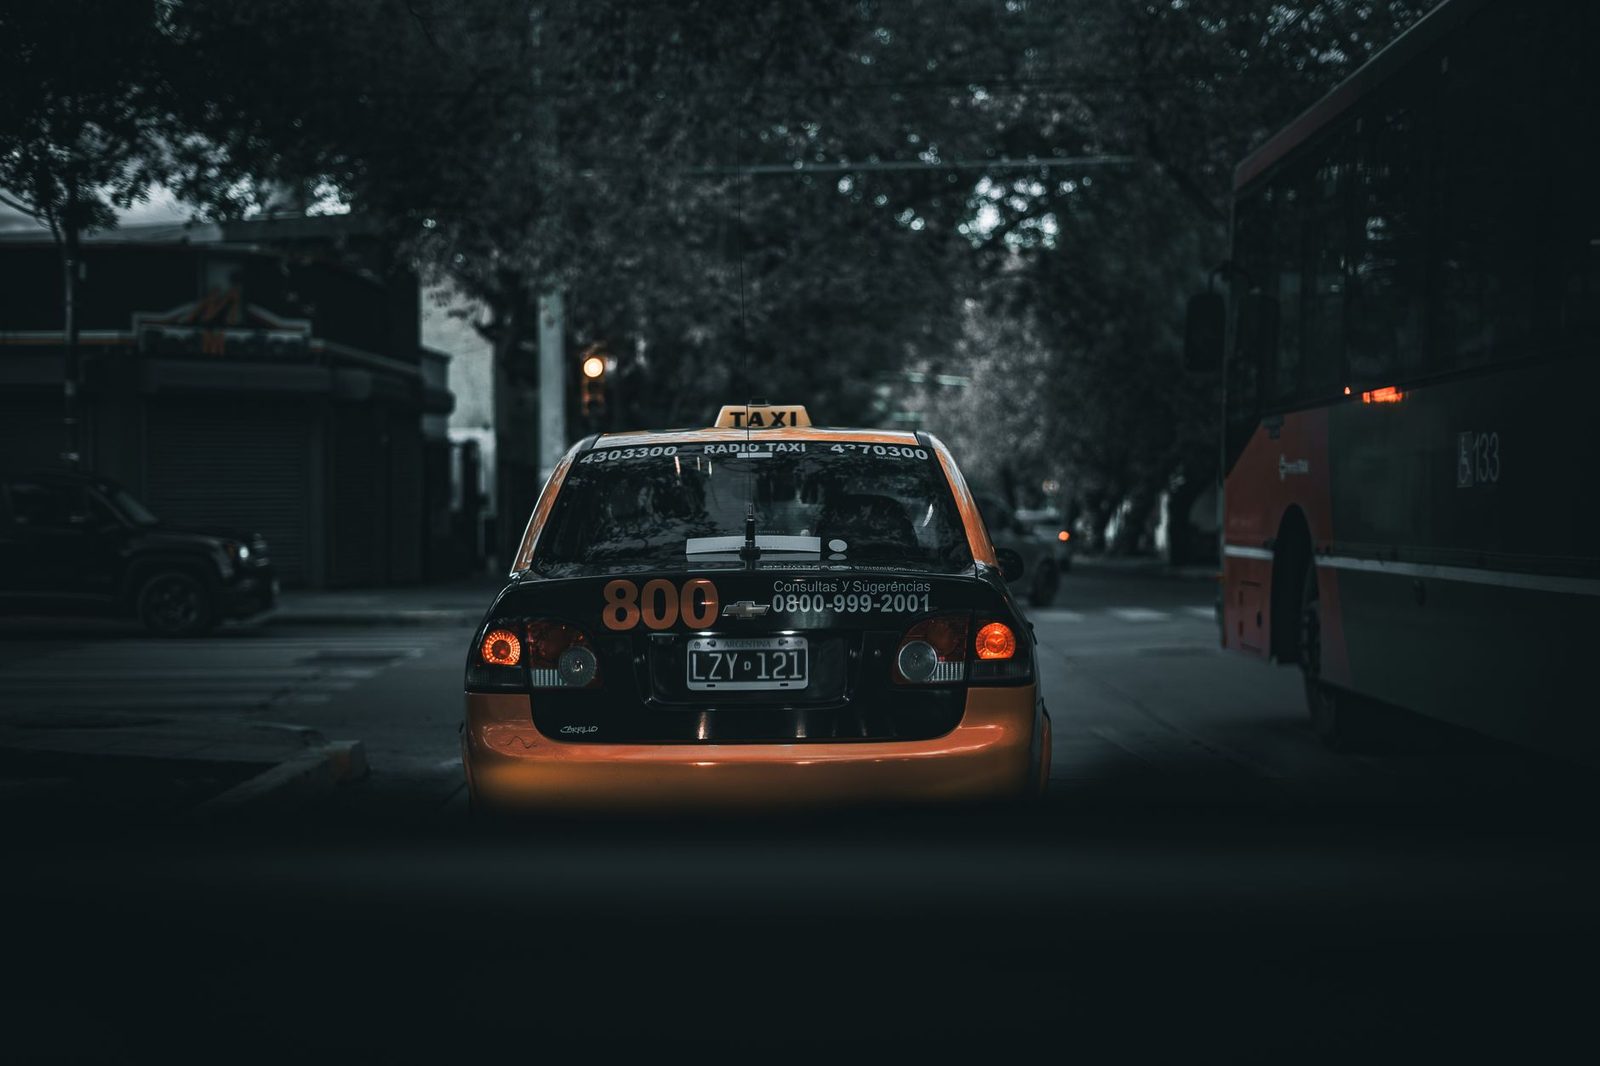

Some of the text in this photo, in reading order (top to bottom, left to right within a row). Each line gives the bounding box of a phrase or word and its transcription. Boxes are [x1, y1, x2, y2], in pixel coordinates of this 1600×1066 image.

[730, 411, 797, 428] TAXI
[579, 446, 678, 464] 4303300
[703, 442, 806, 454] RADIO TAXI
[1472, 431, 1499, 482] 133
[773, 580, 838, 592] Consultas
[601, 577, 719, 631] 800
[772, 593, 930, 613] 0800-999-2001
[723, 639, 771, 648] ARGENTINA
[692, 652, 738, 680] LZY
[756, 651, 803, 680] 121
